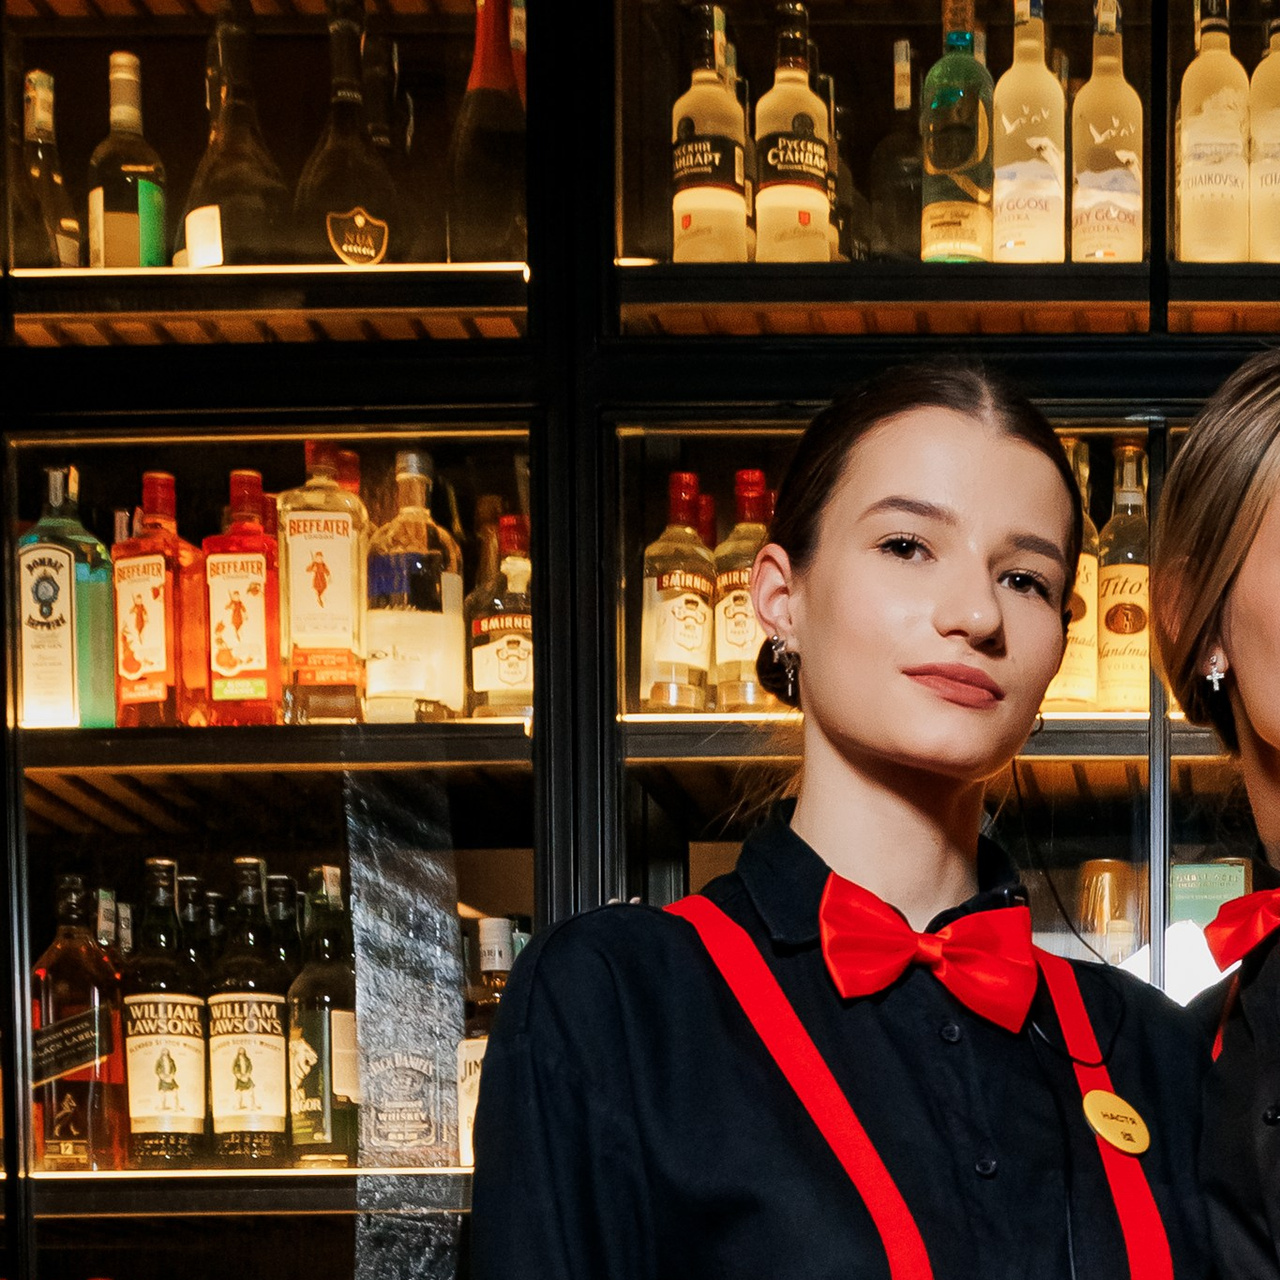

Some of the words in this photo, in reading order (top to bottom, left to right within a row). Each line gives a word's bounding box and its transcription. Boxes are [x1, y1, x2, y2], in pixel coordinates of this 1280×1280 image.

[289, 518, 350, 538] BEEFEATER
[117, 562, 162, 583] BEEFEATER
[209, 560, 263, 578] BEEFEATER
[129, 1003, 199, 1022] WILLIAM
[210, 1003, 277, 1019] WILLIAM
[127, 1019, 203, 1039] LAWSON'S
[377, 1112, 427, 1122] WHISKEY
[60, 1142, 74, 1155] 12
